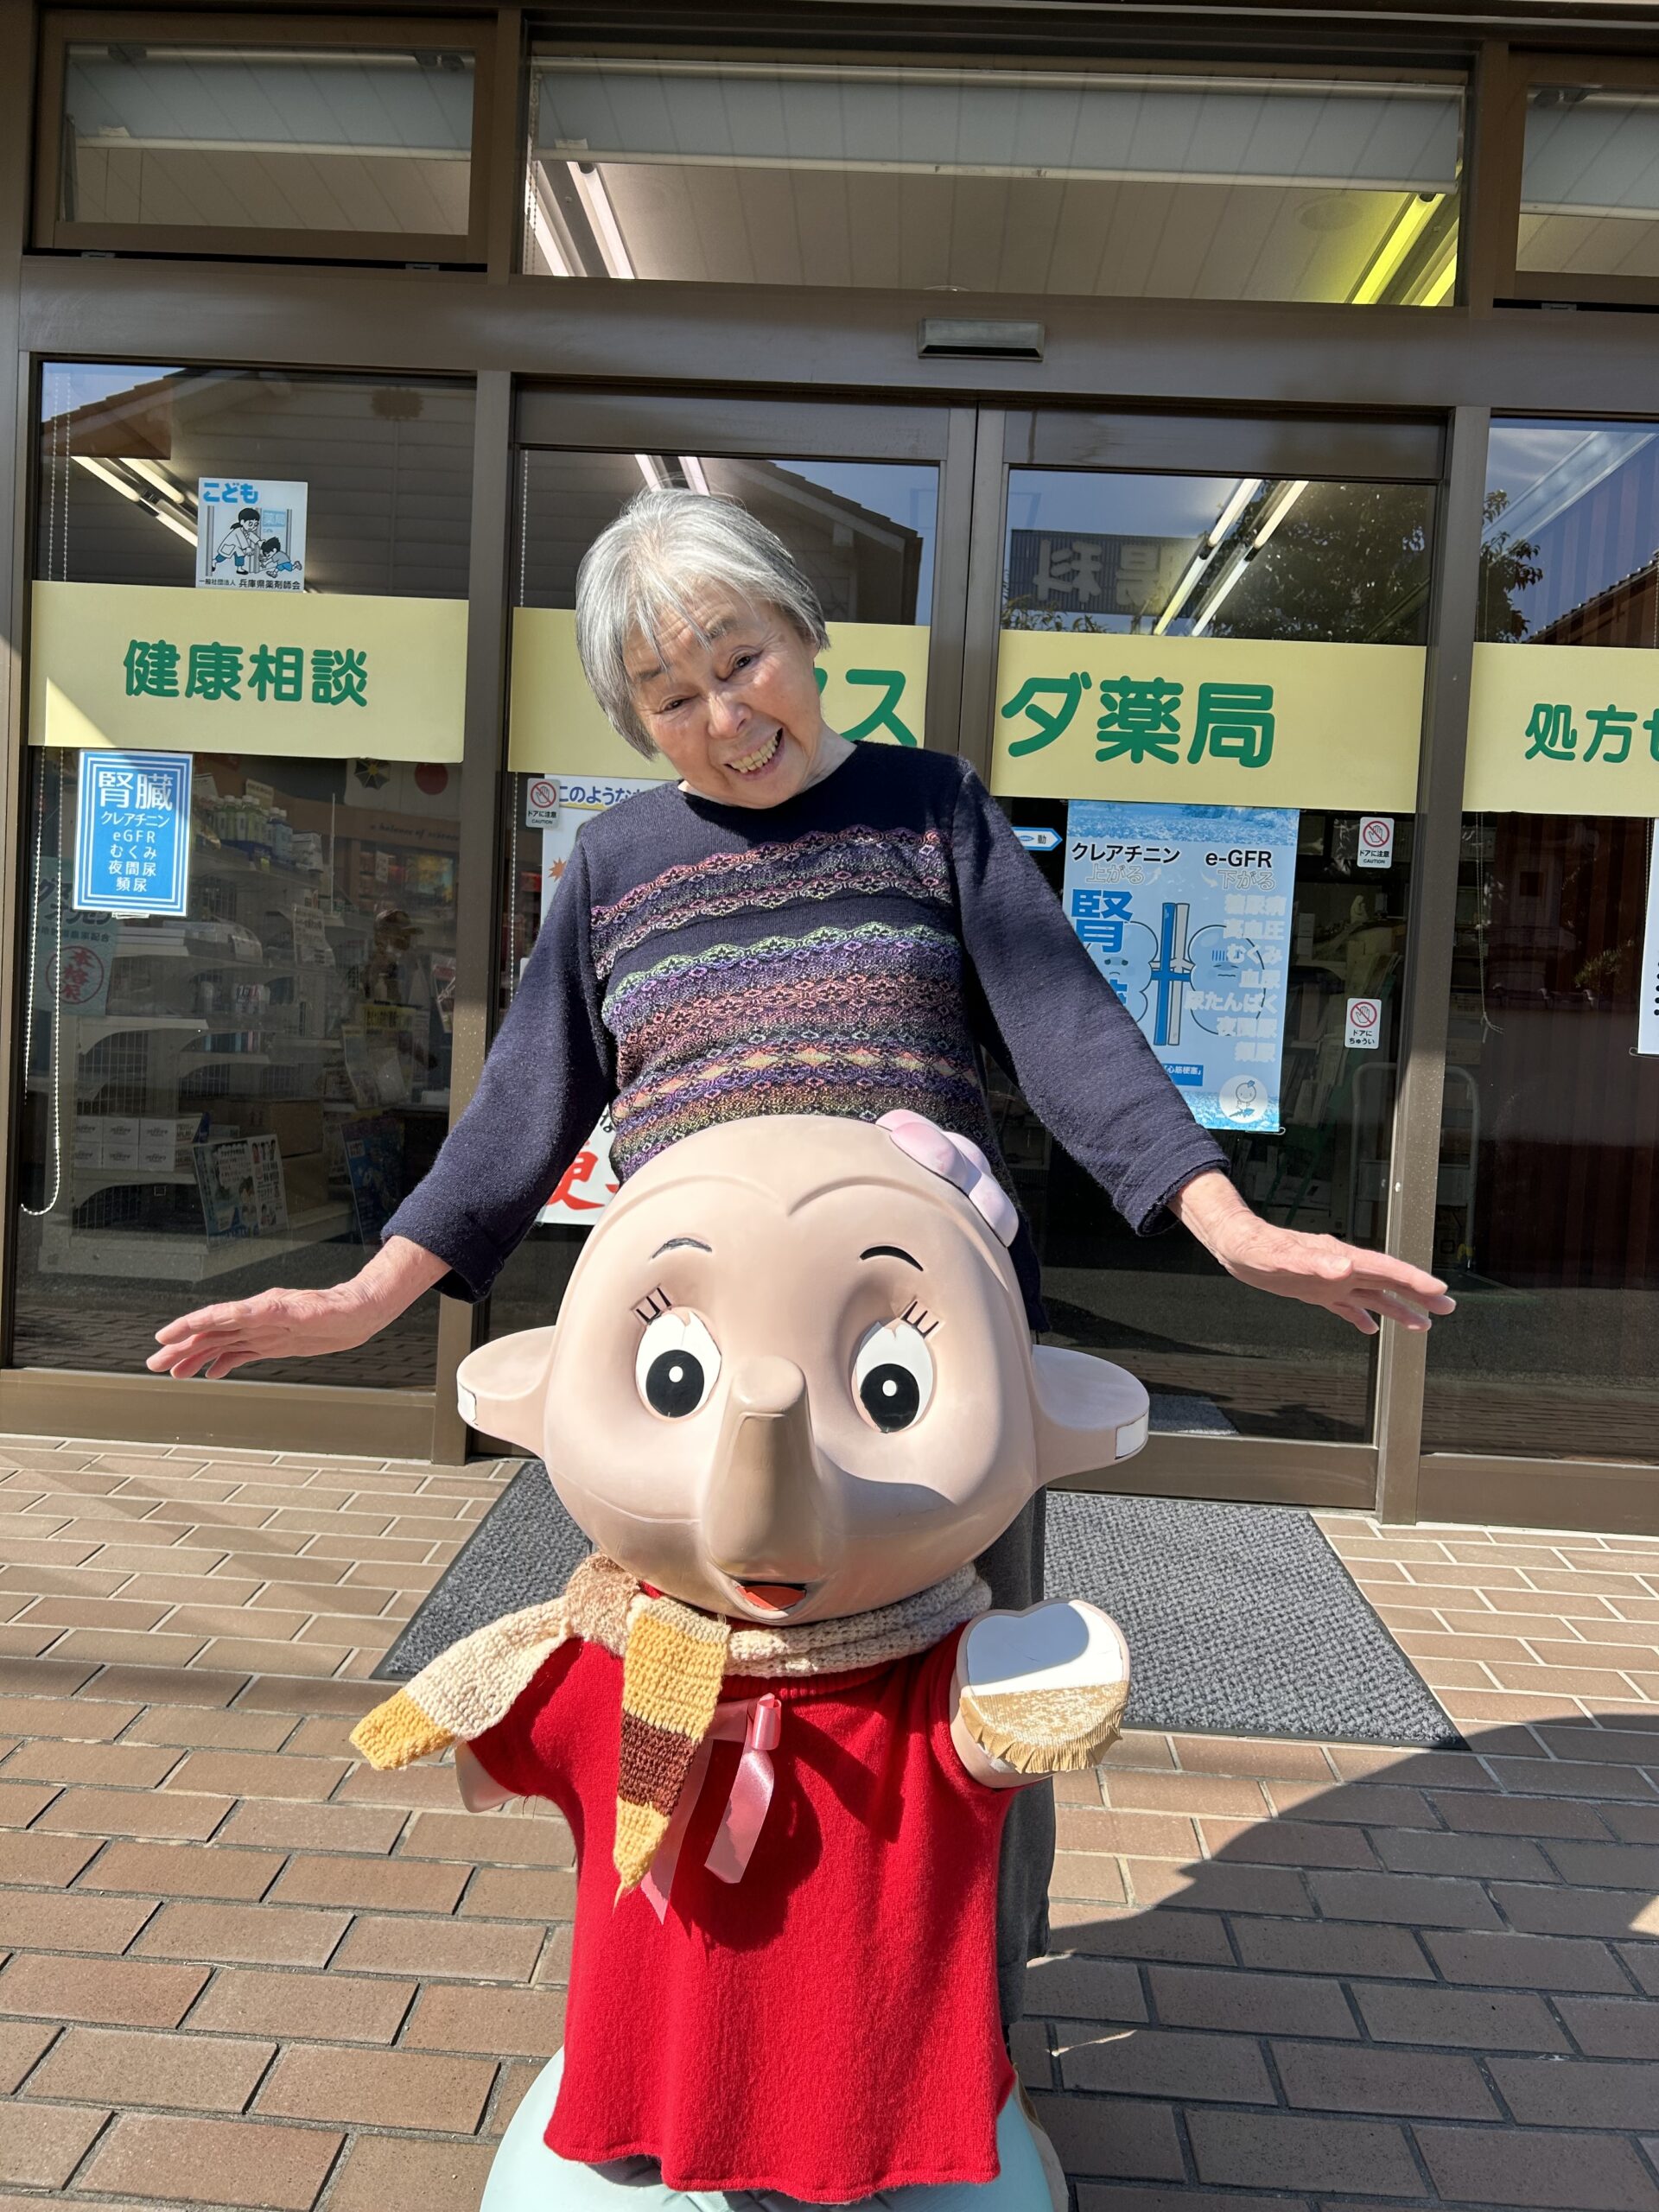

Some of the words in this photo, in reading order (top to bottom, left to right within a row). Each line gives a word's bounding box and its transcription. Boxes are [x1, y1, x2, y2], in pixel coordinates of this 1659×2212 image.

[203, 482, 258, 504] こども
[238, 580, 301, 590] 兵庫県薬剤師会
[123, 639, 368, 708] 健康相談
[1001, 671, 1275, 769] ダ薬局
[98, 772, 174, 810] 腎臓
[559, 785, 644, 806] このような
[100, 811, 170, 828] クレアチニン
[112, 830, 156, 843] eGFR
[110, 844, 157, 860] むくみ
[1071, 842, 1180, 864] クレアチニン
[1205, 849, 1273, 868] e-GFR
[1359, 849, 1389, 858] ドアに注意
[108, 861, 156, 877] 夜間尿
[1086, 863, 1145, 885] 上がる
[116, 876, 148, 893] 頻尿
[1217, 868, 1276, 891] 下がる
[1223, 918, 1285, 940] 高血圧
[1226, 944, 1283, 965] むくみ
[1238, 969, 1281, 989] 血尿
[1349, 1037, 1375, 1046] ちゅうい
